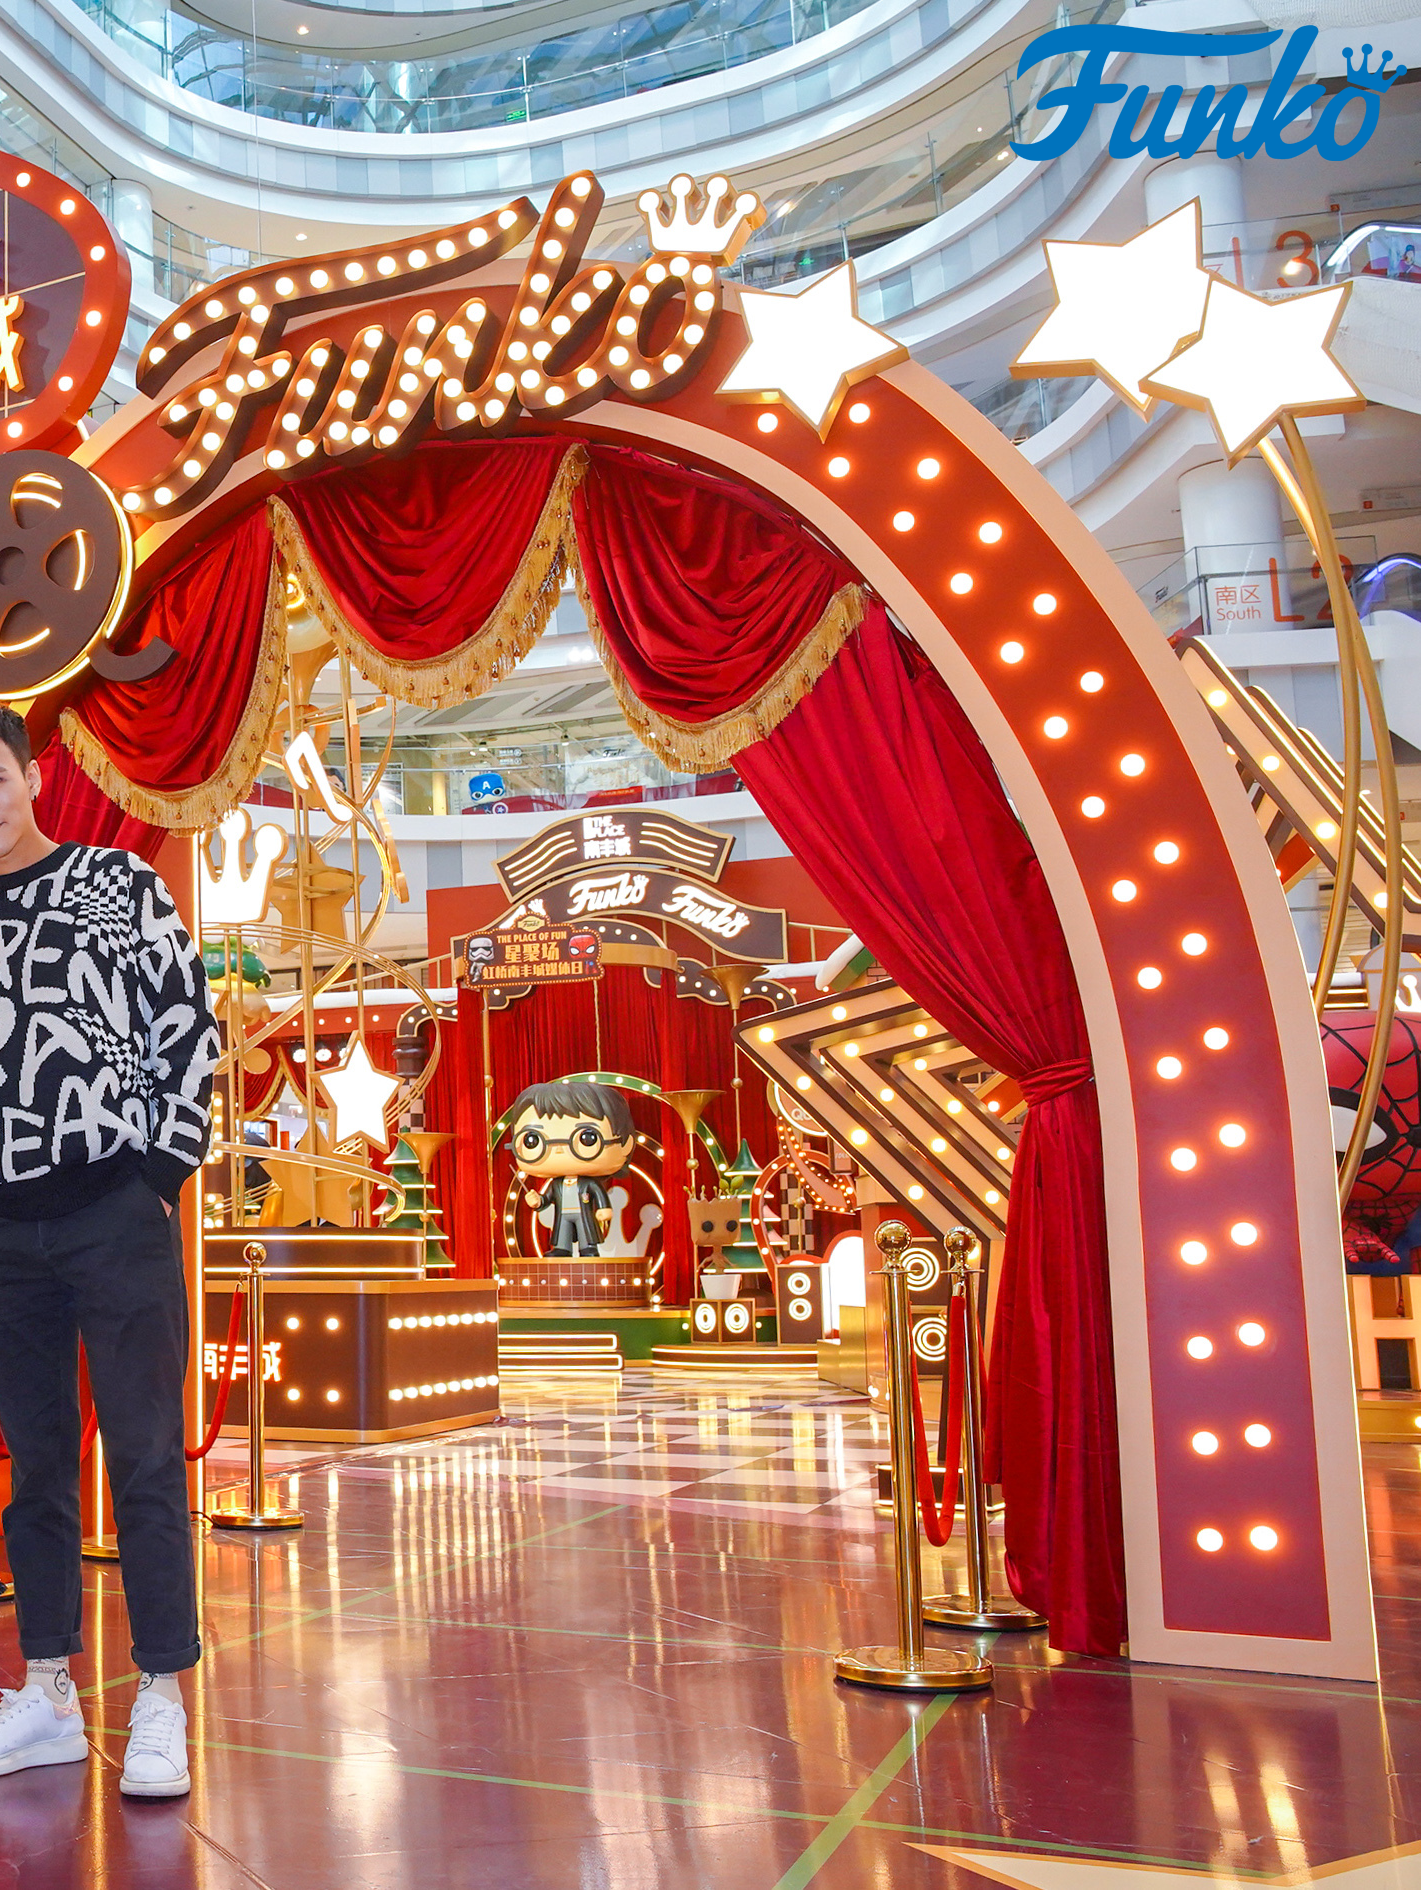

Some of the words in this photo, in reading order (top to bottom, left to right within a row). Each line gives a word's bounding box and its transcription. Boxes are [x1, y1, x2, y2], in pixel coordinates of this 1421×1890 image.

[113, 170, 723, 522] Funko
[1214, 584, 1262, 606] 南区
[1216, 606, 1261, 622] South
[566, 872, 649, 916] Funko
[661, 885, 748, 938] Funko
[496, 935, 512, 944] THE
[514, 933, 538, 943] PLACE
[539, 932, 550, 942] OF
[551, 931, 567, 941] FUN
[505, 941, 560, 964] 星聚场
